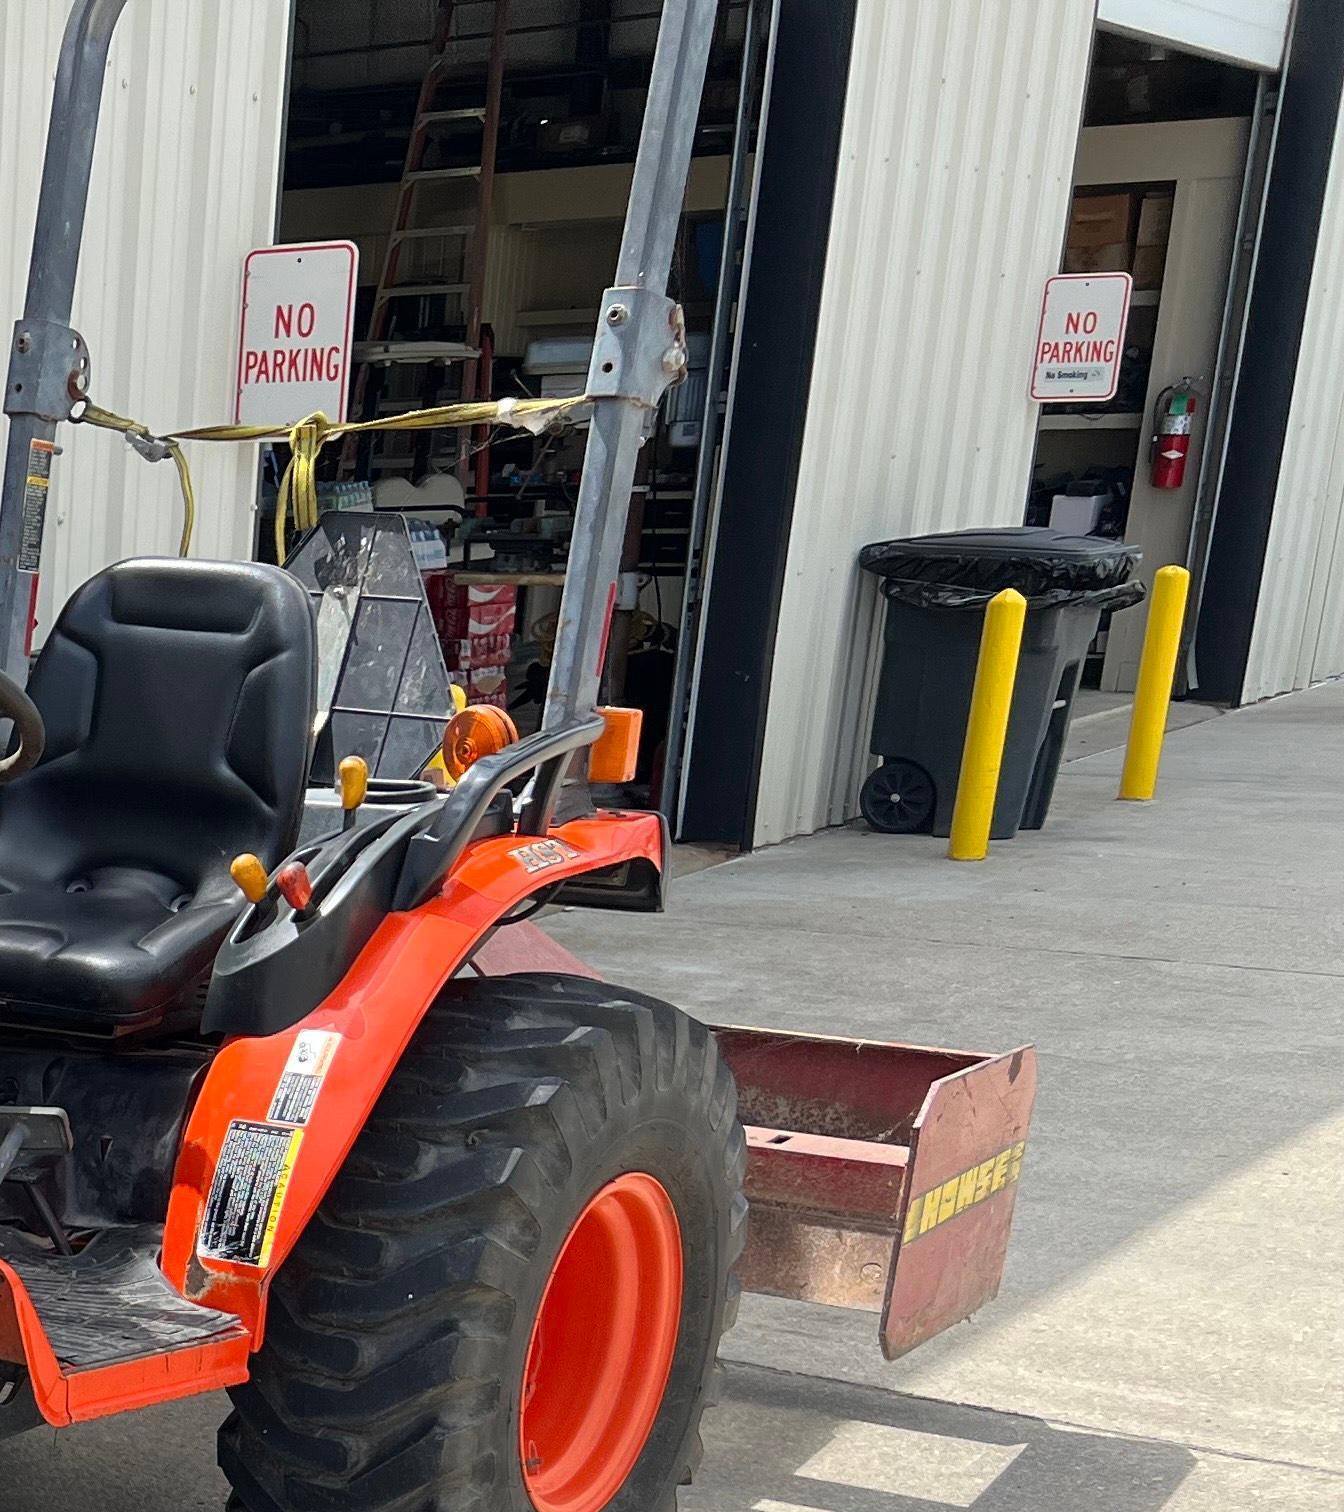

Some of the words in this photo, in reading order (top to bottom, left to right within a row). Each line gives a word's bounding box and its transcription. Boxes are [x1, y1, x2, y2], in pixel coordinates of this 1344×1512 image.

[274, 303, 316, 339] NO
[1065, 312, 1098, 335] NO
[244, 346, 341, 385] PARKING
[1040, 340, 1115, 364] PARKING
[1045, 371, 1056, 380] No
[1057, 370, 1089, 380] Smoking
[507, 839, 582, 874] HST
[266, 1170, 288, 1233] CAUTION
